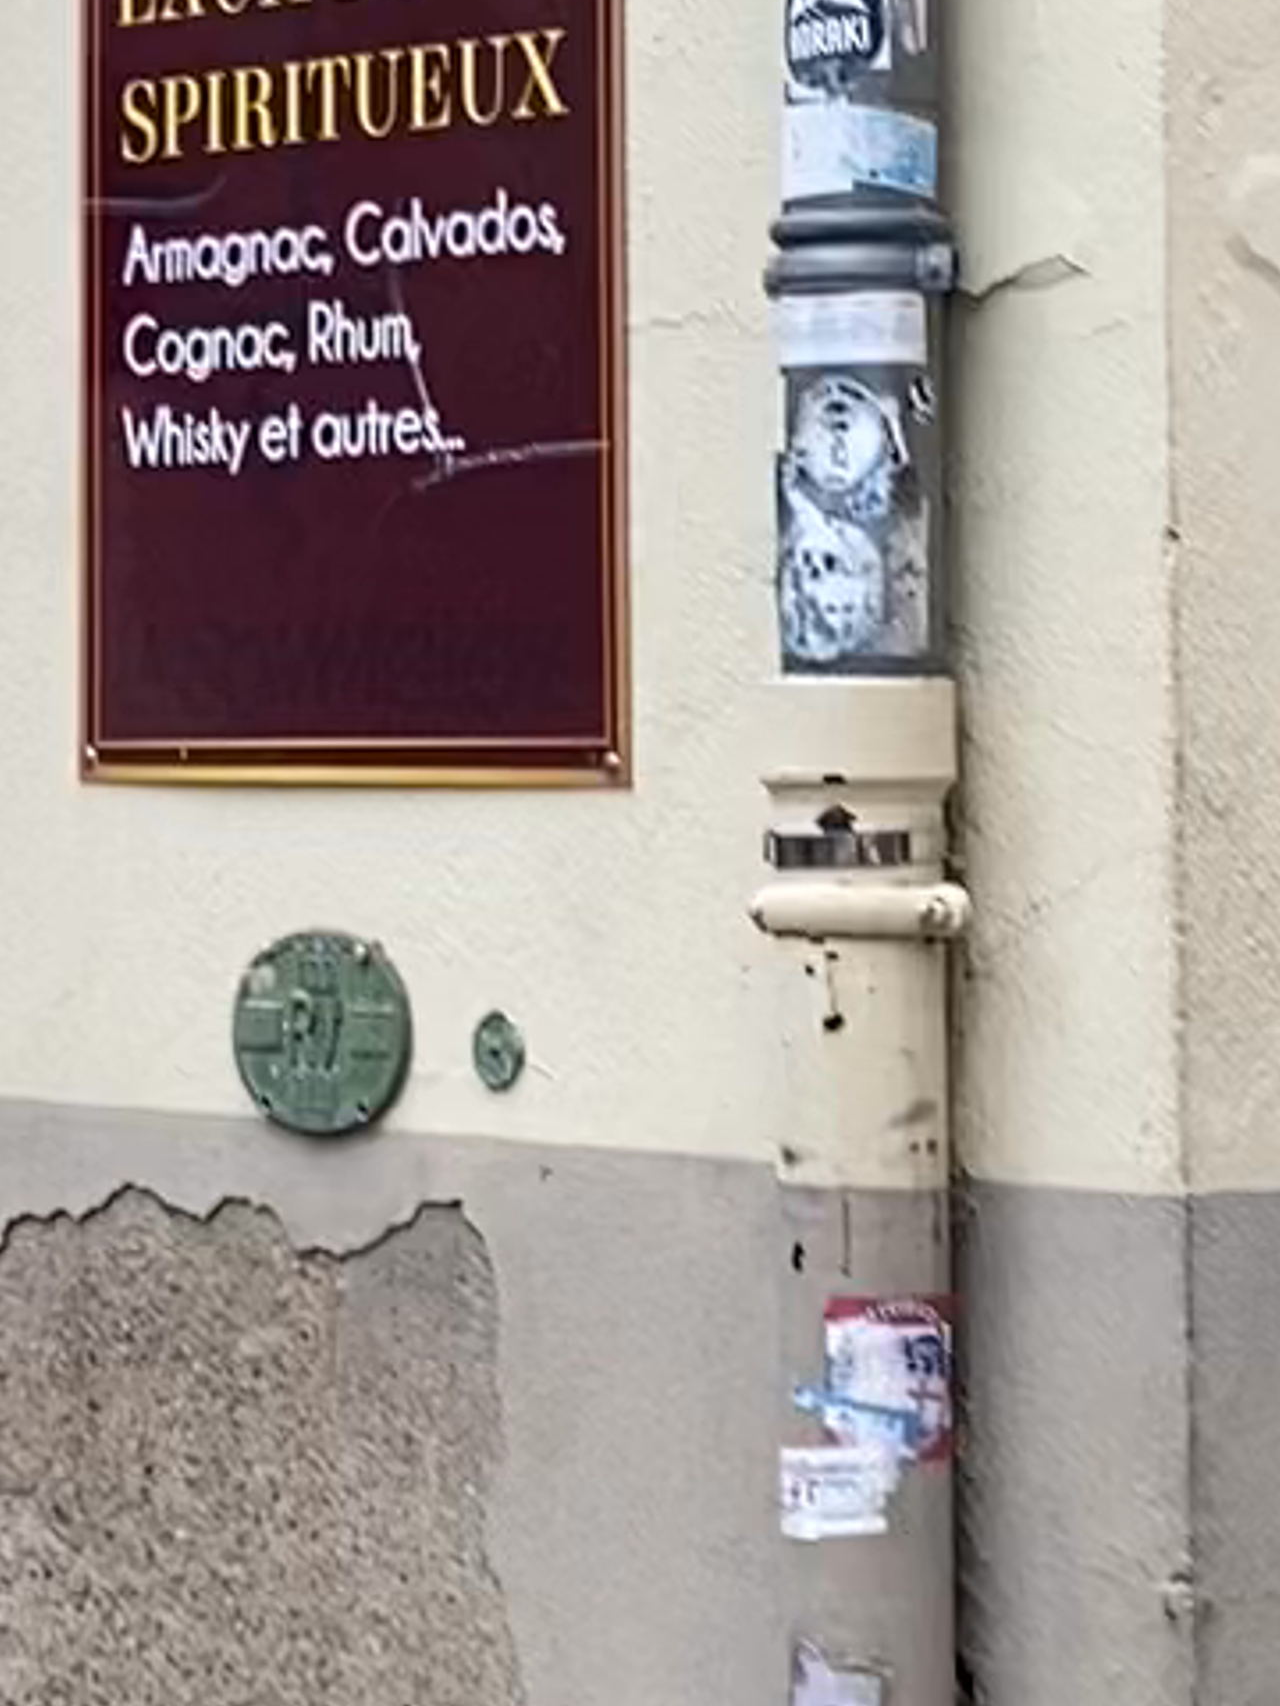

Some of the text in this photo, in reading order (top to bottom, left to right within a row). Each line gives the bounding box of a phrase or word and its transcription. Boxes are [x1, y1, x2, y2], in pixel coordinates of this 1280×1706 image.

[121, 28, 570, 164] SPIRITUEUX
[122, 189, 566, 289] Armagnac, Calvados,
[122, 297, 422, 385] Cognac, Rhum,
[122, 404, 251, 475] Whisky
[258, 404, 304, 461] et
